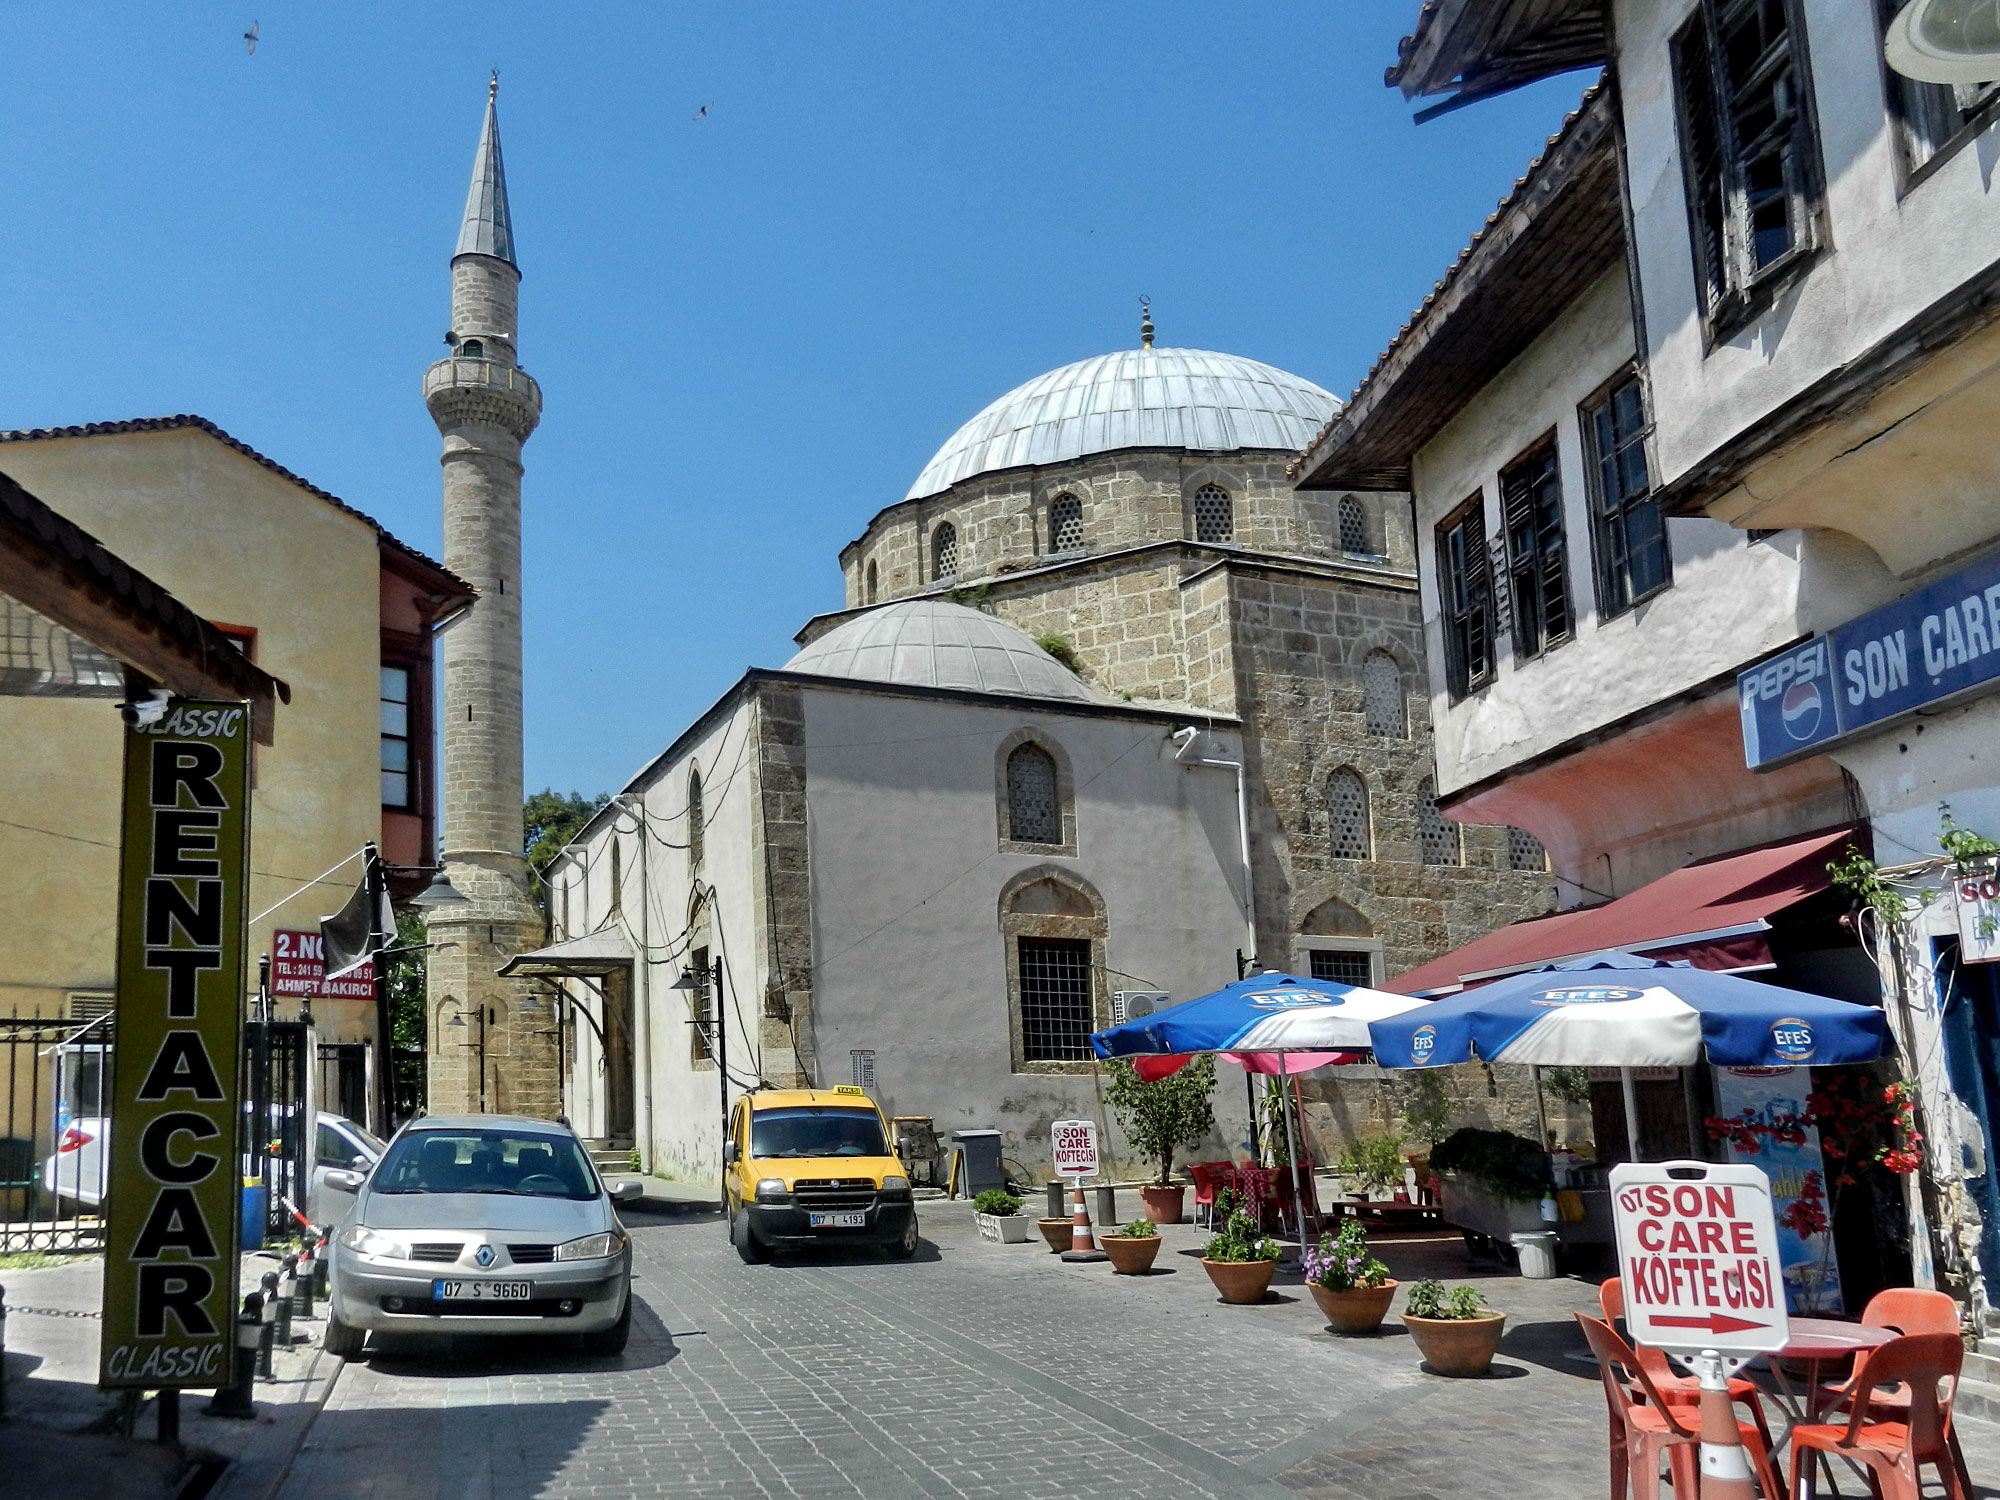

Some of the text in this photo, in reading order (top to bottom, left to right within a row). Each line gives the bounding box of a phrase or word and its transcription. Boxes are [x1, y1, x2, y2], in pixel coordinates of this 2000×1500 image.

[1845, 630, 1909, 706] SON
[1743, 643, 1824, 710] PEPSI
[278, 962, 292, 975] TEL
[276, 979, 320, 993] AHMET
[1250, 994, 1332, 1004] EFES
[1544, 991, 1628, 1000] EFES
[128, 740, 228, 1338] RENT A CAR
[1413, 1035, 1434, 1050] EFES
[1773, 1030, 1812, 1045] EFES
[1063, 1128, 1087, 1138] SON
[1059, 1139, 1091, 1148] CARE
[1619, 1185, 1736, 1218] 07 SON
[815, 1215, 863, 1225] 07 T 4193
[1637, 1219, 1758, 1254] CARE
[445, 1282, 461, 1296] 07
[473, 1283, 482, 1297] S
[493, 1283, 528, 1298] 9660
[108, 1343, 224, 1378] CLASSIC
